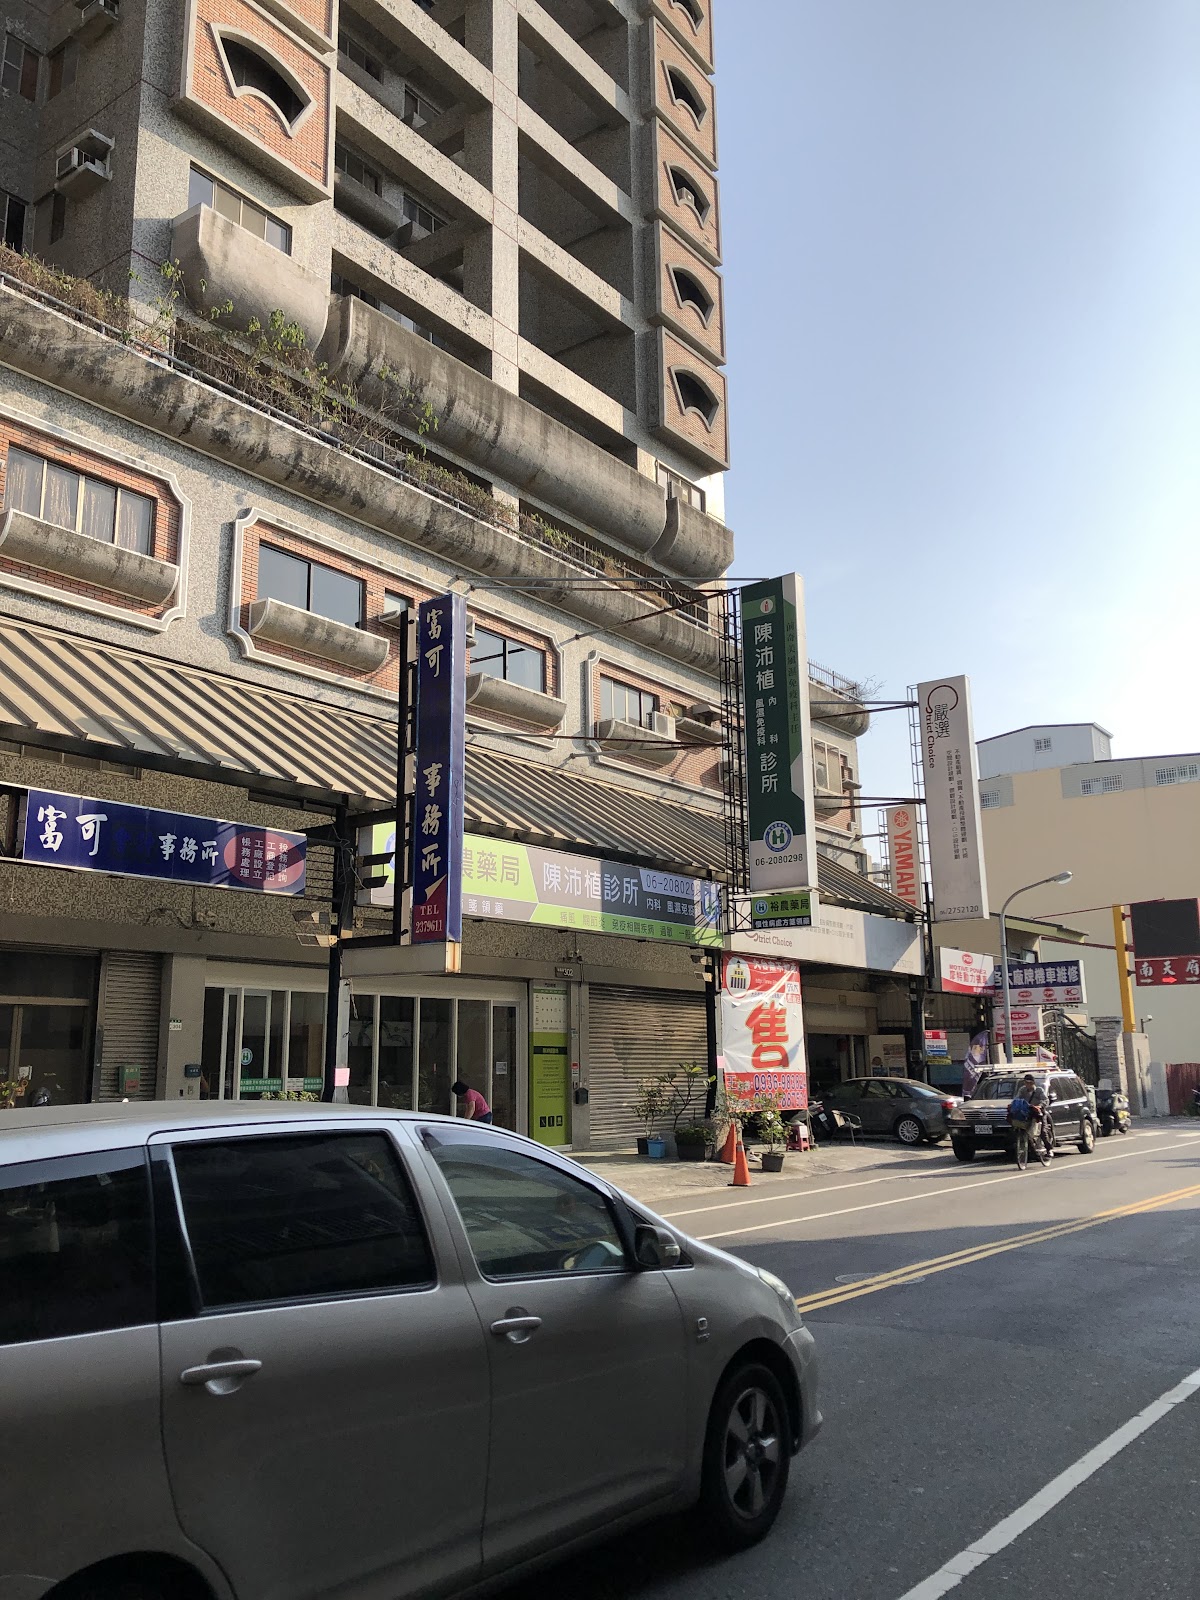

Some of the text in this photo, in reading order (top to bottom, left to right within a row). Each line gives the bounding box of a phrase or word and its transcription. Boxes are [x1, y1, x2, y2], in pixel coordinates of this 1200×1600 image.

[754, 623, 778, 794] 陳沛植 診所
[421, 608, 444, 877] 富可 事務所
[927, 735, 936, 769] Choice
[37, 804, 108, 856] 富可
[158, 832, 220, 867] 事務所
[253, 839, 264, 880] 工廠設立
[265, 841, 276, 881] 工商登記
[755, 853, 803, 867] 06-2080298
[543, 861, 639, 907] 陳沛植診所
[420, 905, 439, 916] TEL
[646, 898, 661, 912] 內科
[770, 898, 809, 912] 裕農藥局
[415, 920, 443, 934] 2379611
[772, 935, 793, 948] Choice
[1140, 960, 1200, 977] 南天府
[745, 1000, 790, 1070] 售
